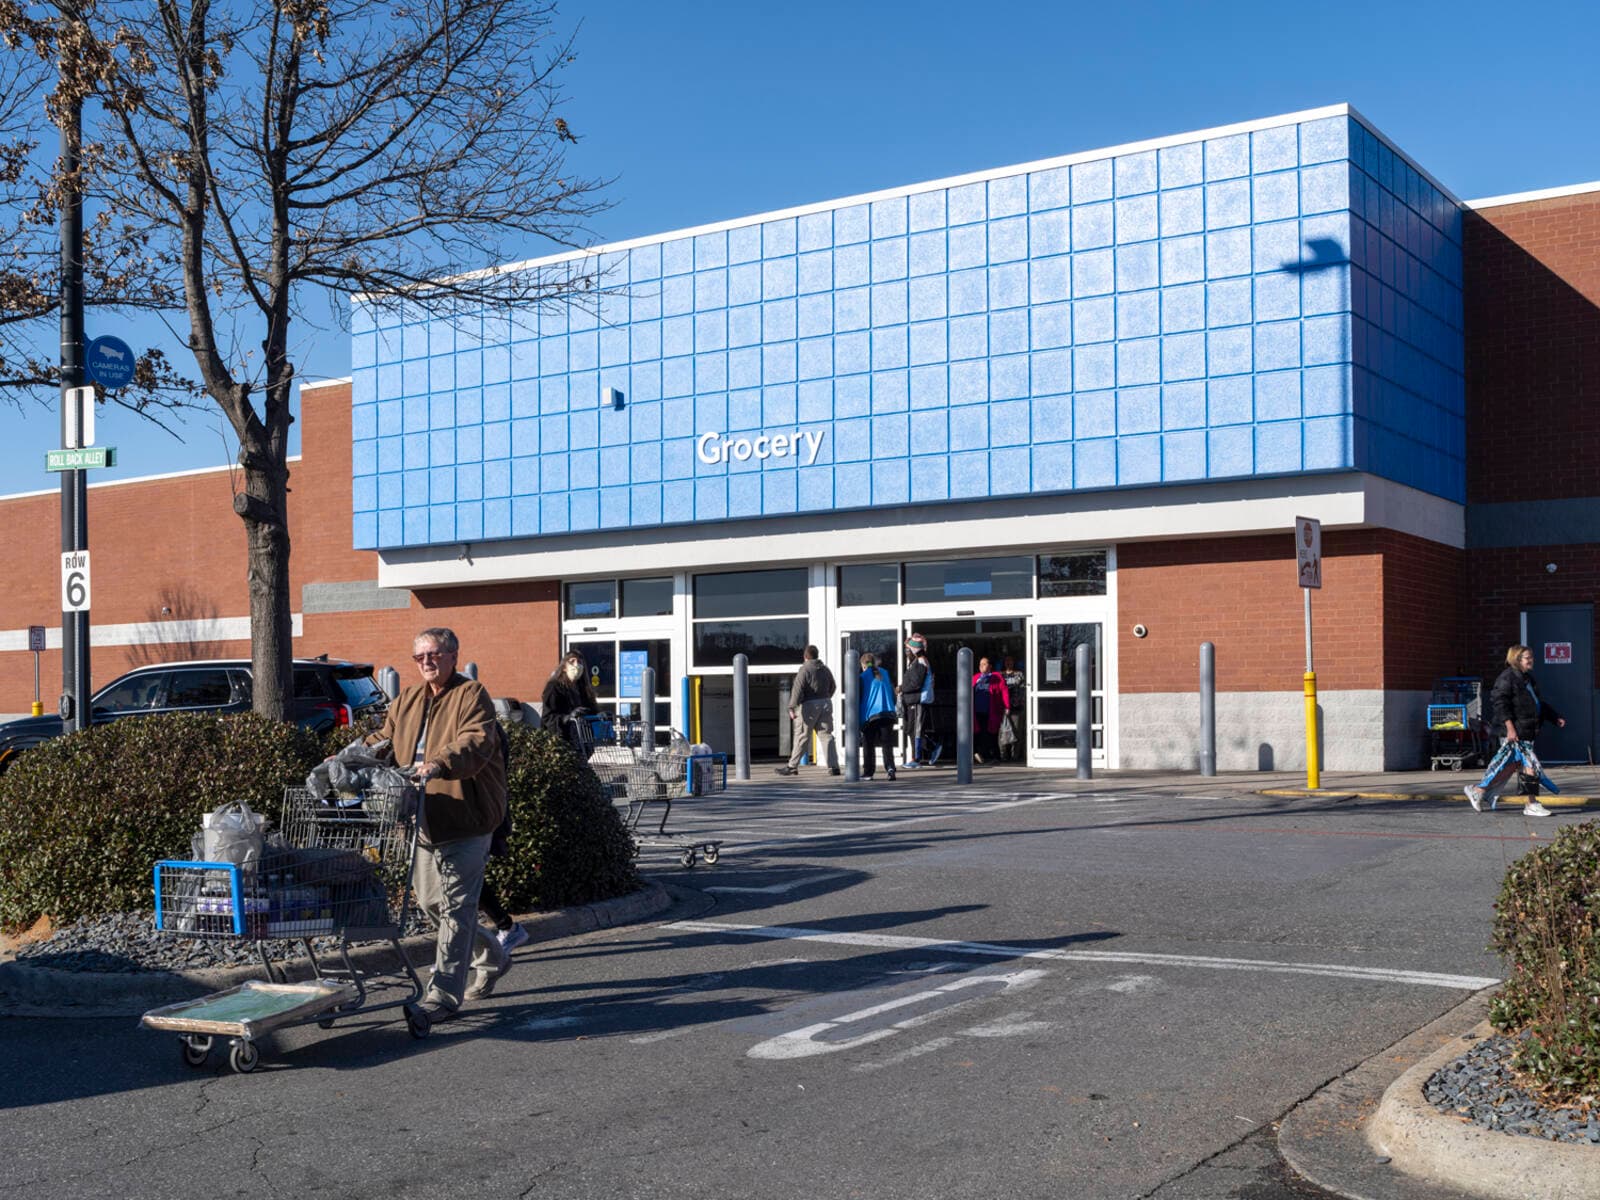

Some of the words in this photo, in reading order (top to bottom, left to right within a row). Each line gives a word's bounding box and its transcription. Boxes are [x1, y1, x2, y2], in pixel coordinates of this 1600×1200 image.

[49, 454, 64, 466] ROLL
[66, 452, 83, 466] BACK
[84, 451, 104, 465] ALLEY
[697, 430, 825, 465] Grocery
[65, 555, 86, 569] ROW
[66, 571, 86, 607] 6
